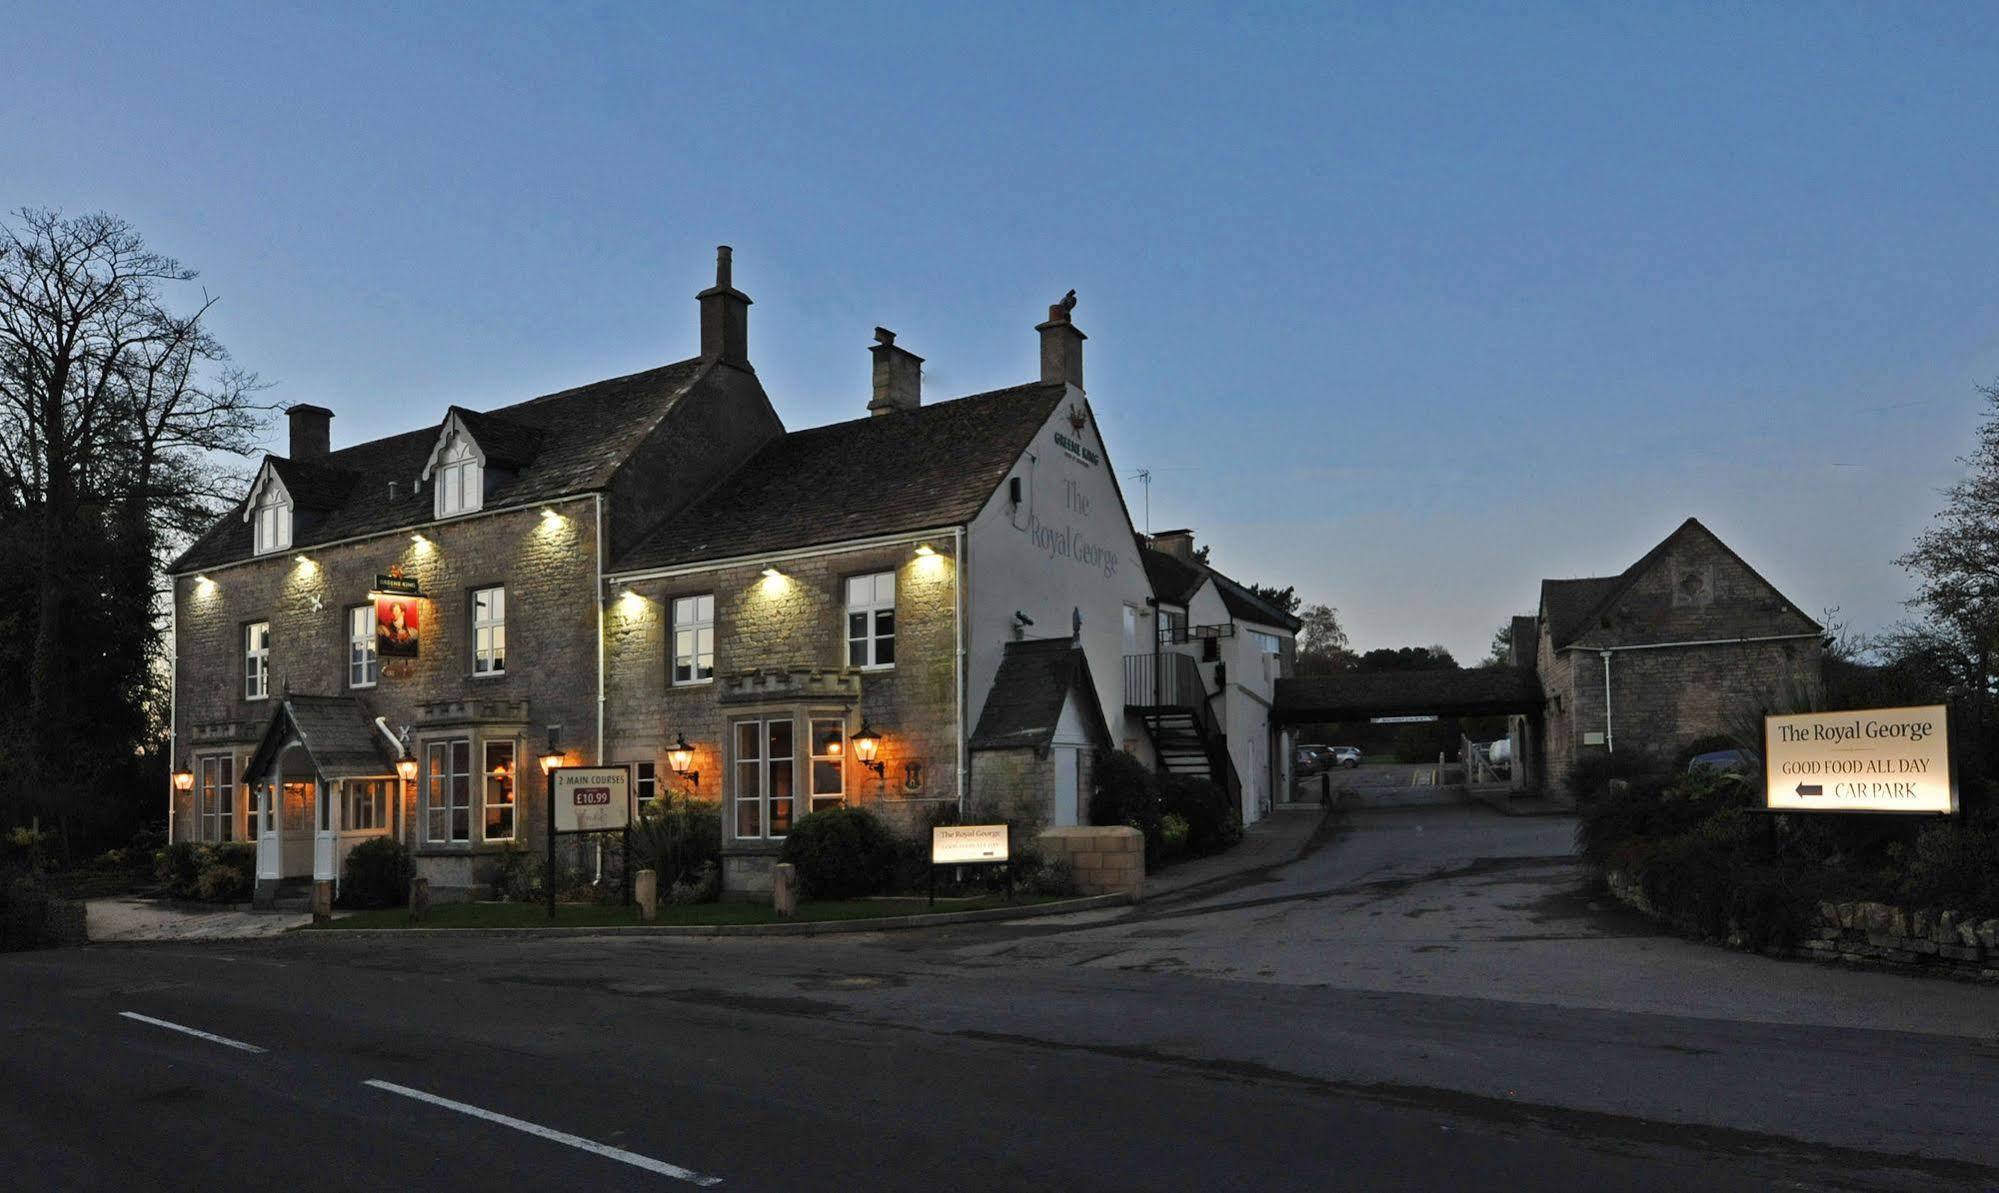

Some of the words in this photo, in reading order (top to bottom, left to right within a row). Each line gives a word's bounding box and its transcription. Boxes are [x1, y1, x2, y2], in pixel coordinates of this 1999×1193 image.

[1064, 479, 1089, 516] The
[1031, 515, 1070, 559] Royal
[1073, 533, 1118, 578] George
[1779, 724, 1809, 742] The
[1814, 721, 1860, 744] Royal
[1866, 721, 1932, 741] George
[1782, 761, 1821, 775] GOOD
[1825, 760, 1863, 774] FOOD
[1867, 759, 1895, 774] ALL
[1899, 758, 1930, 773] DAY
[567, 776, 588, 784] MAIN
[591, 775, 625, 784] COURSES
[577, 793, 607, 804] £10.99
[1835, 782, 1870, 798] CAR
[1873, 782, 1917, 798] PARK
